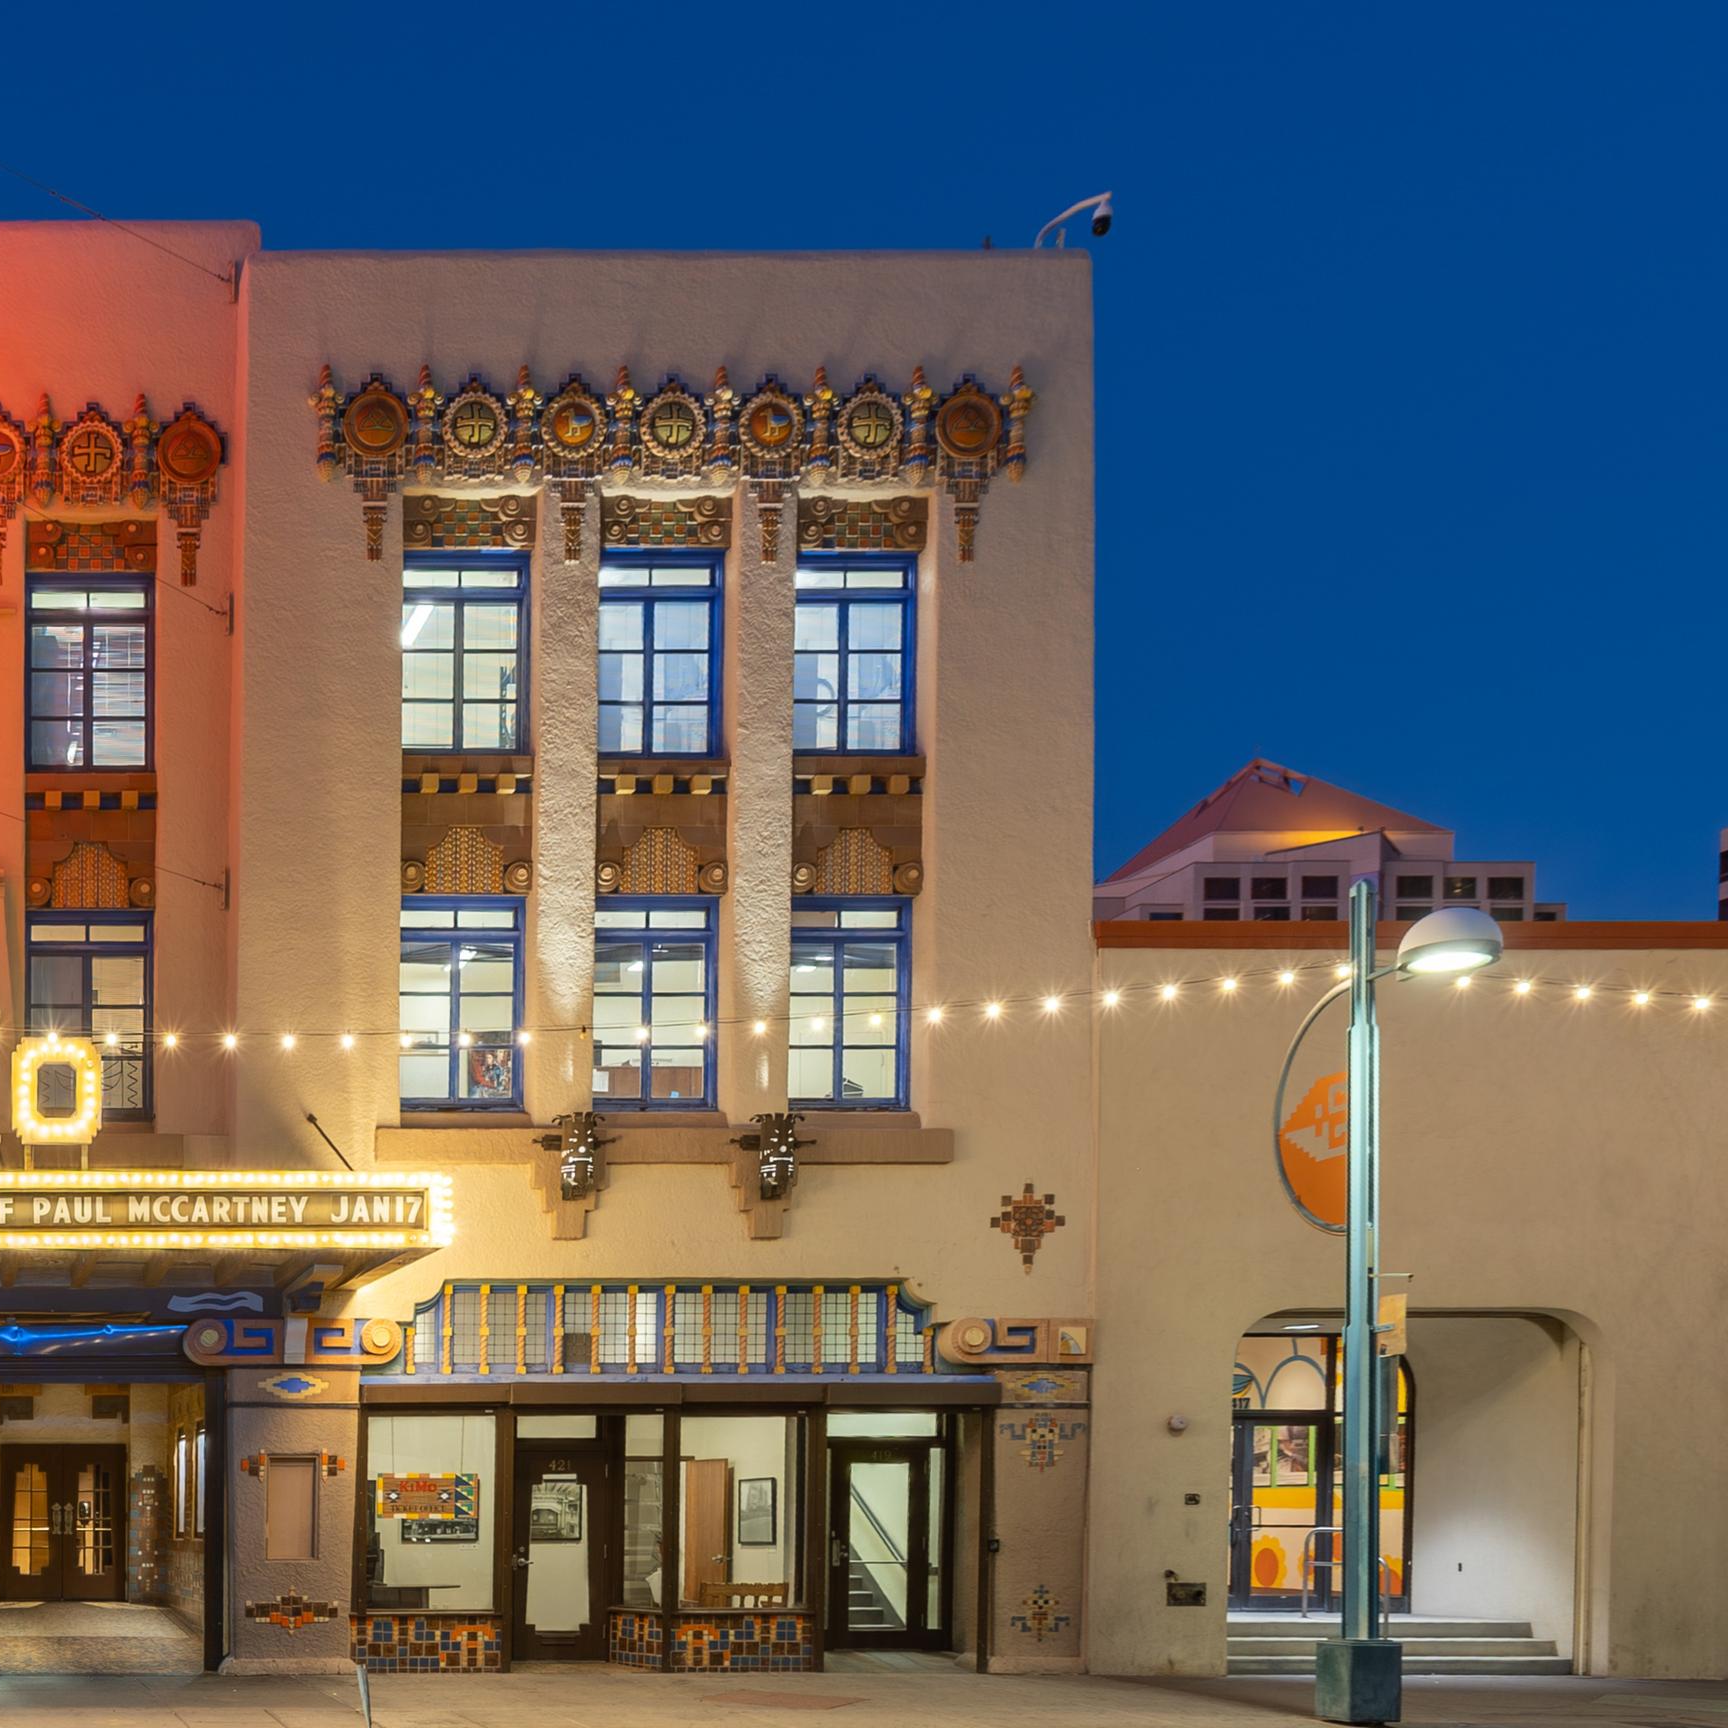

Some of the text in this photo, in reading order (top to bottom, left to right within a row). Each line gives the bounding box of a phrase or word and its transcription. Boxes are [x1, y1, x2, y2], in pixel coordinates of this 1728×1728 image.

[32, 1196, 112, 1224] PAUL
[128, 1195, 309, 1224] MCCARTNEY
[548, 1459, 571, 1471] 421
